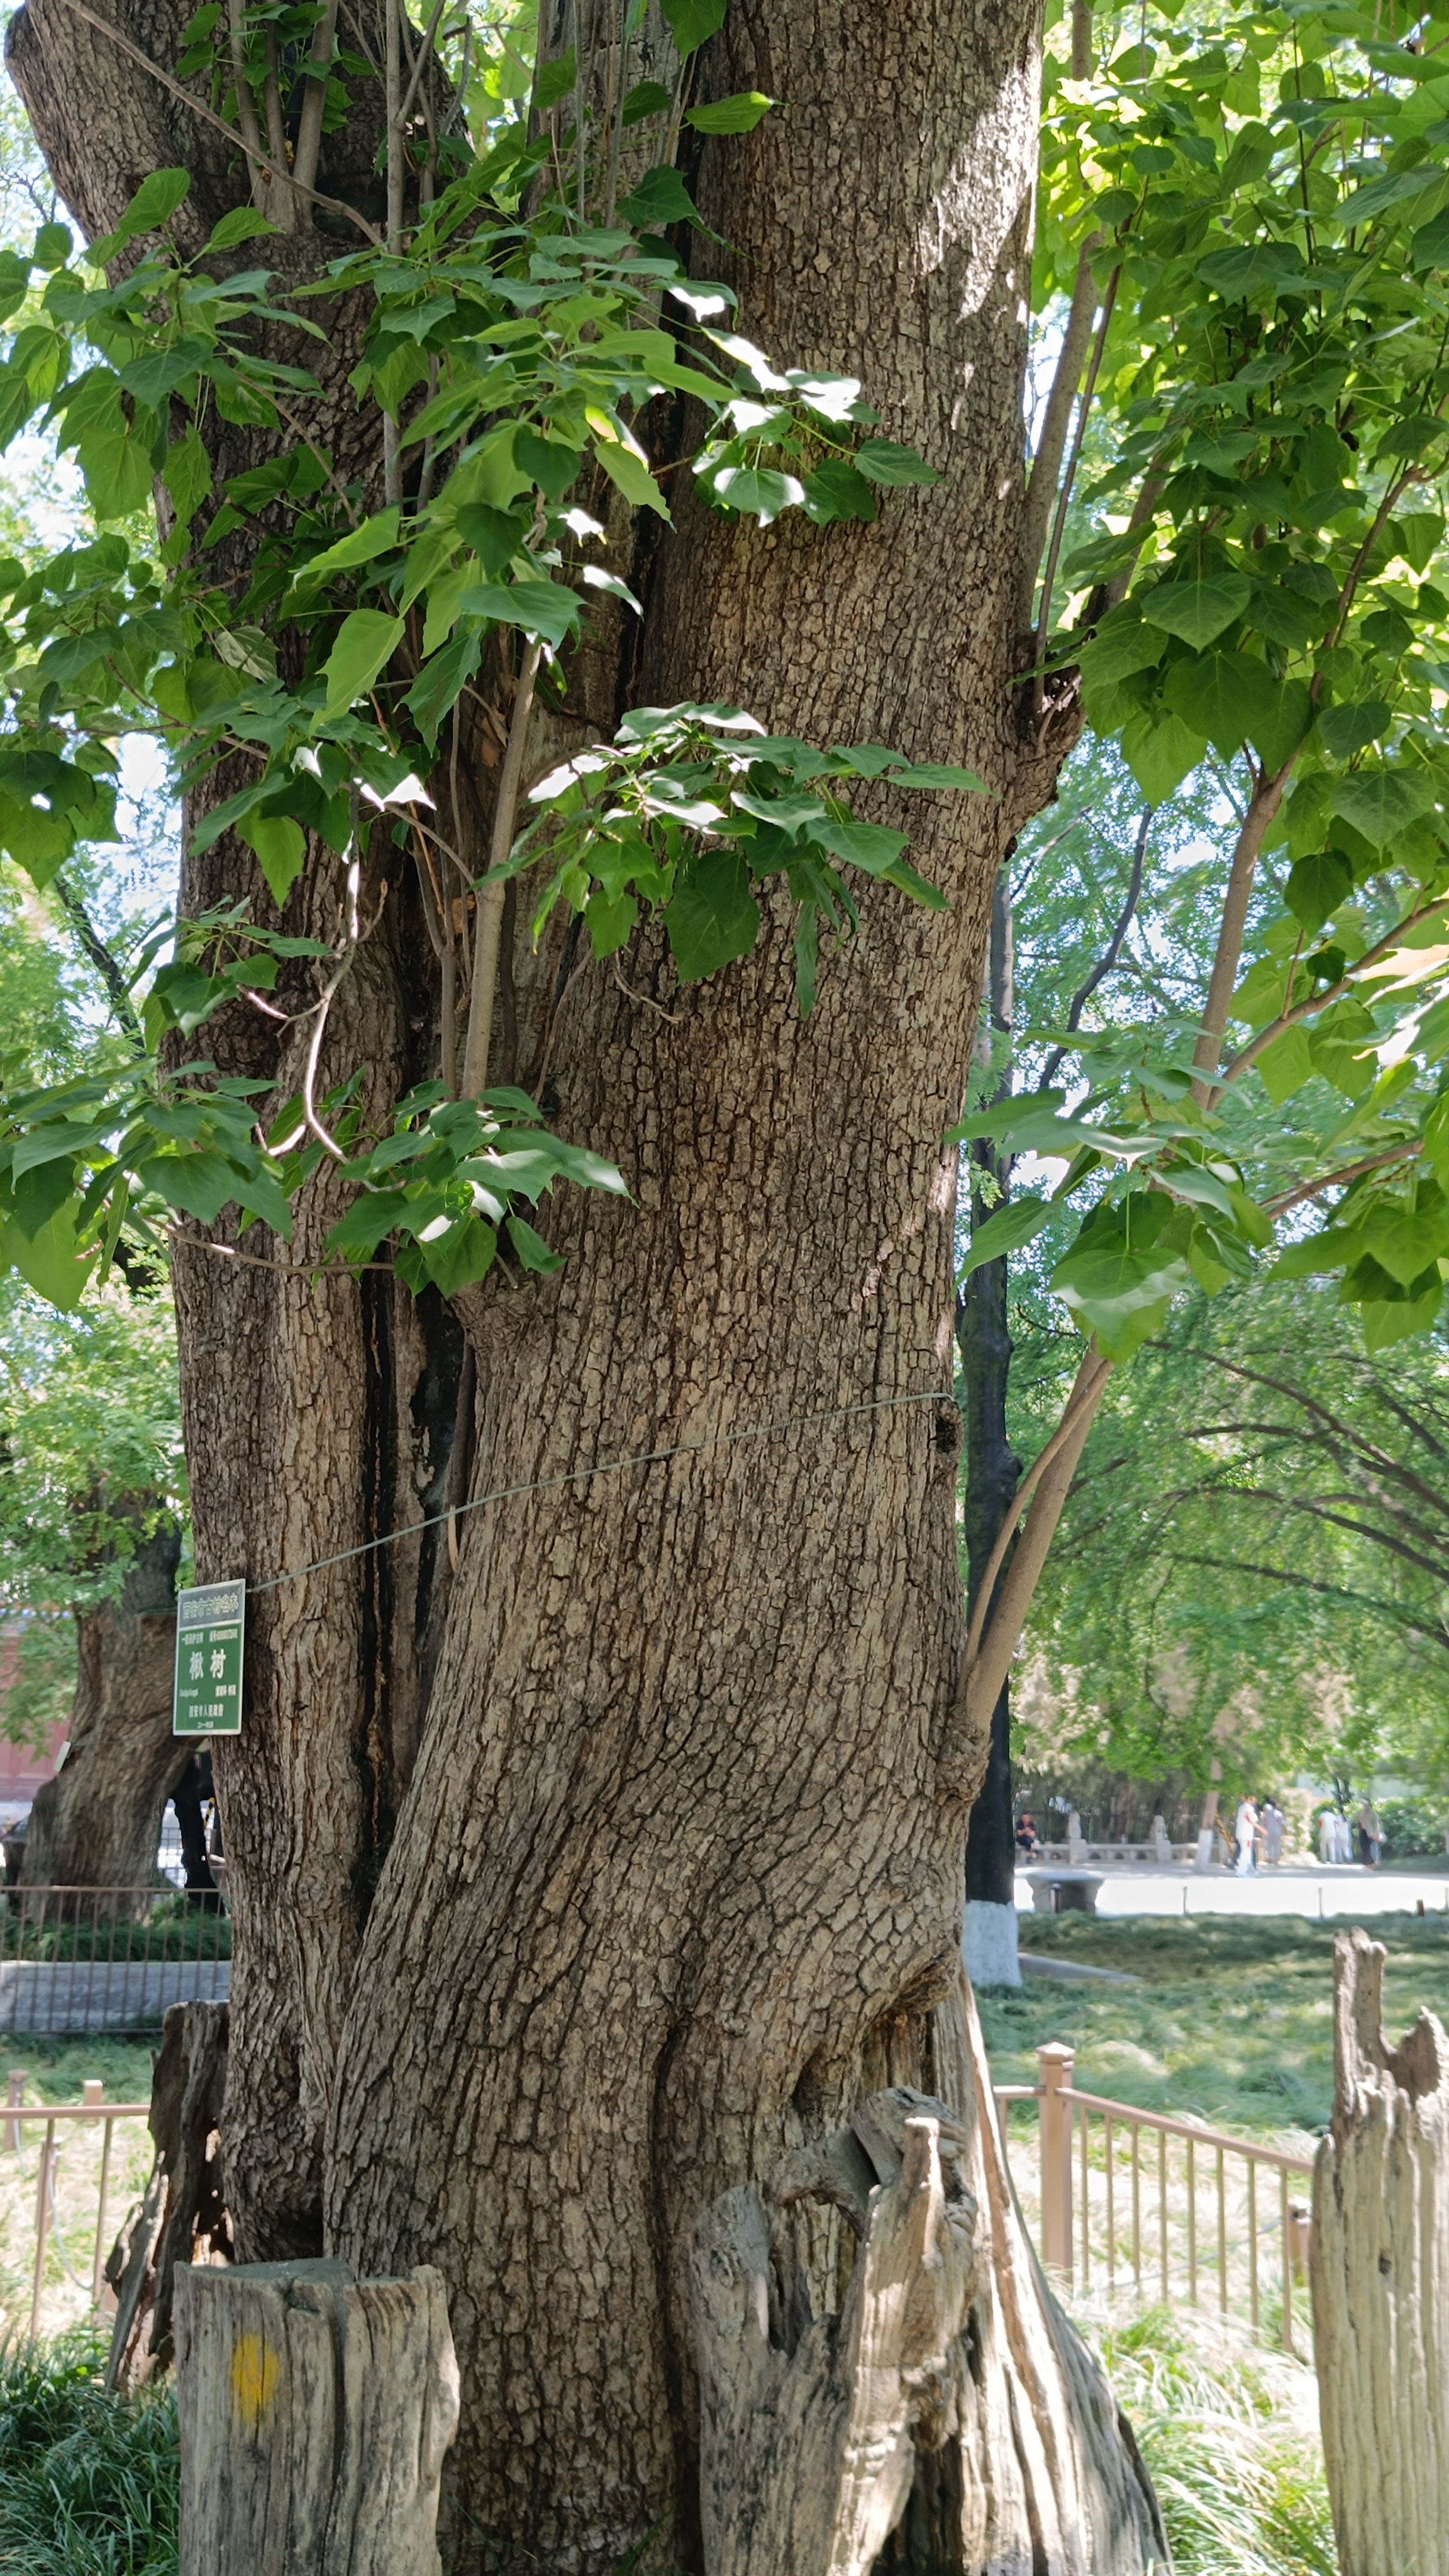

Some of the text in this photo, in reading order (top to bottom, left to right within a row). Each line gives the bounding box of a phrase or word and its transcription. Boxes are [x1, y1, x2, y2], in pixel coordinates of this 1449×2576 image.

[189, 1648, 226, 1680] 楸树
[189, 1703, 224, 1718] 西安市人民政府
